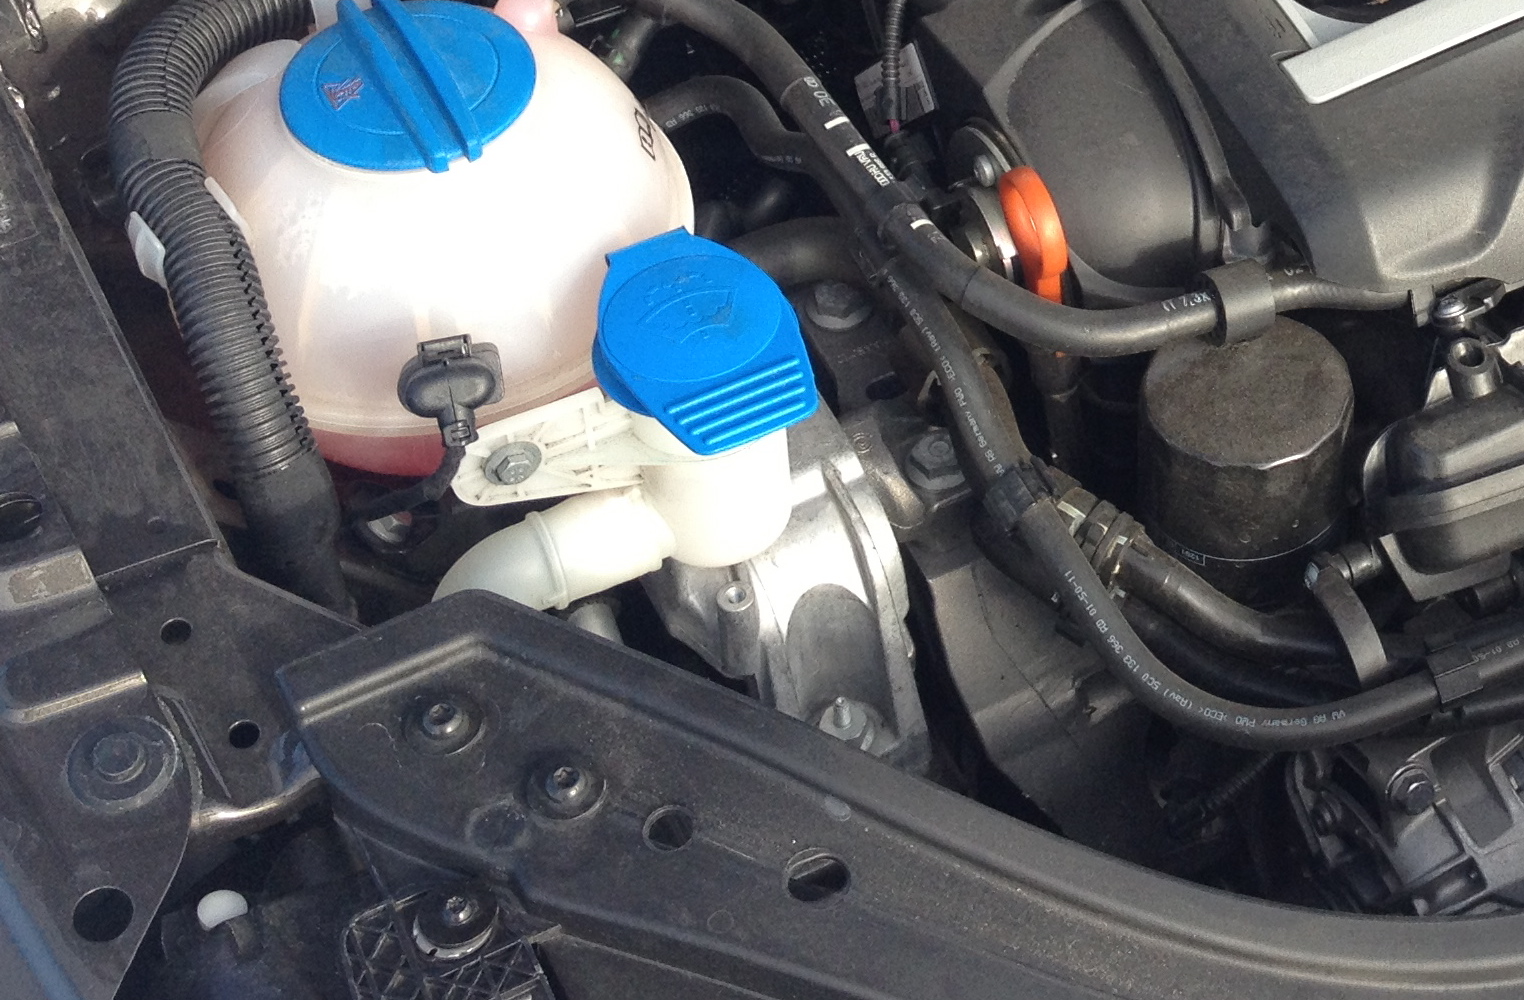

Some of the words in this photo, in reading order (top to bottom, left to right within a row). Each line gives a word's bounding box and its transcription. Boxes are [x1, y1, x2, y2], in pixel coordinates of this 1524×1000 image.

[1106, 632, 1124, 652] 366
[1121, 652, 1140, 672] 133
[1259, 715, 1307, 727] Germany
[1312, 712, 1326, 723] AG
[1330, 709, 1346, 723] VW
